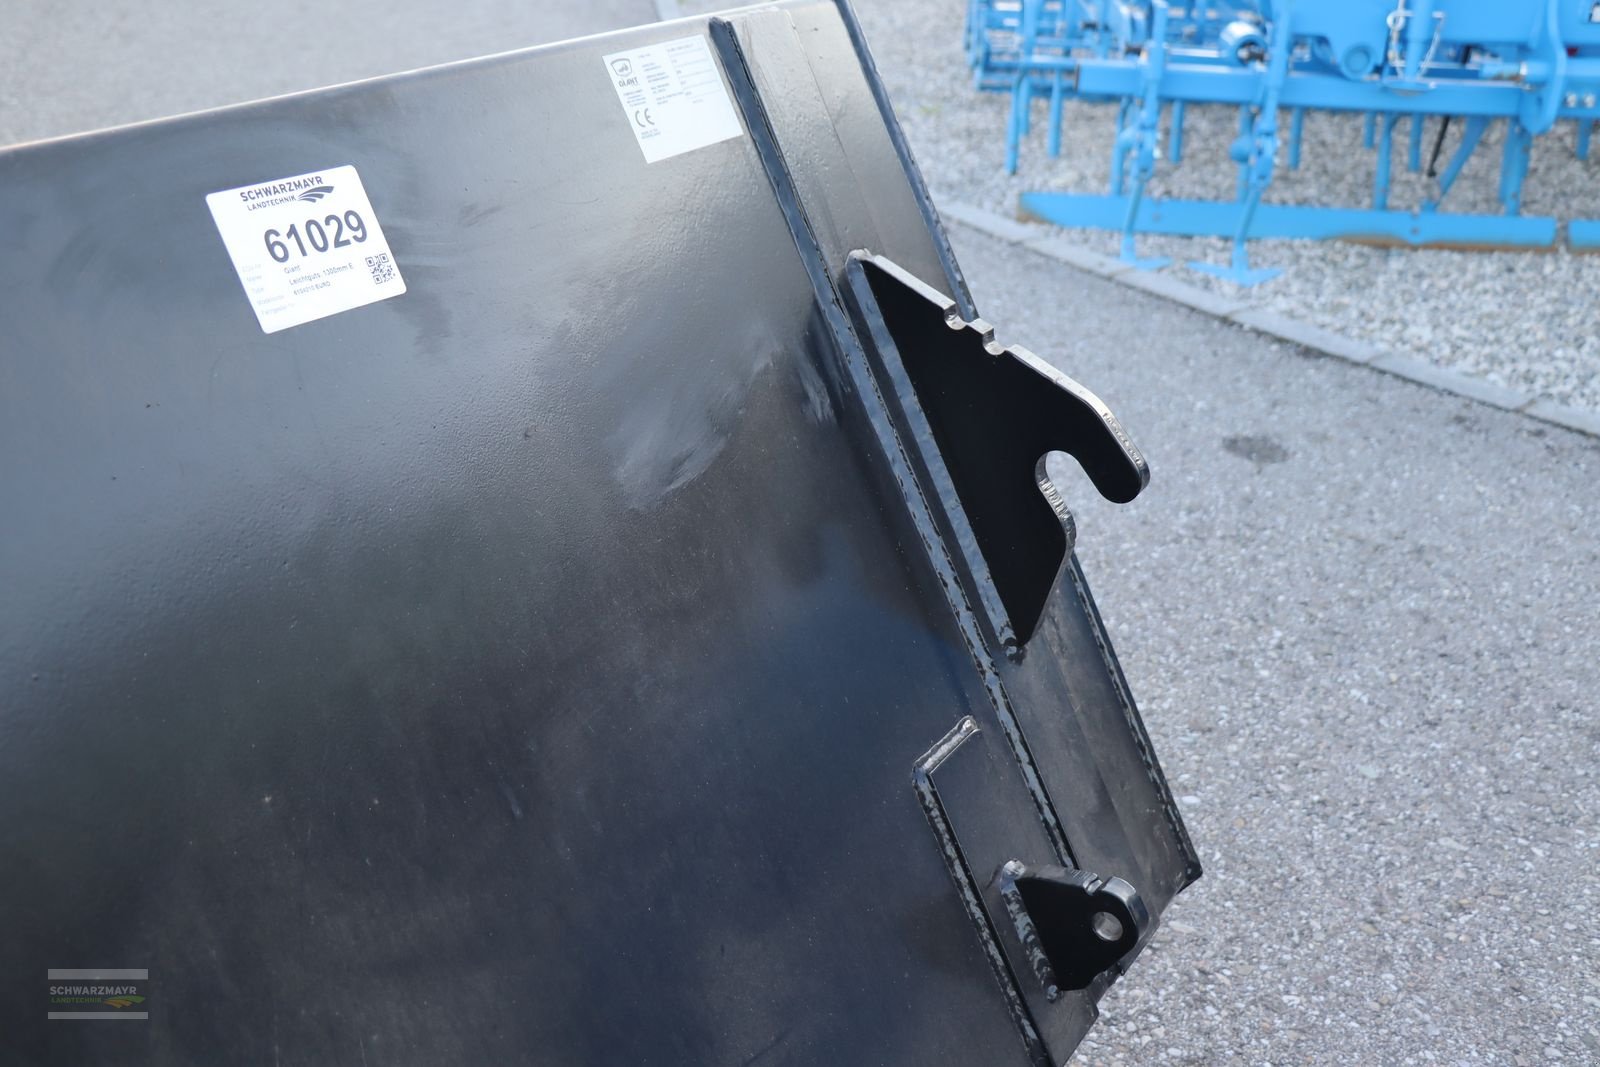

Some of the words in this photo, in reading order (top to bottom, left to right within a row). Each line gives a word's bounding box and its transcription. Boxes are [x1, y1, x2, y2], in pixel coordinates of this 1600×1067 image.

[635, 108, 655, 128] CE
[240, 176, 324, 202] SCHWARZMAYR
[247, 195, 297, 211] LANDTECHNIK
[264, 210, 367, 263] 61029
[284, 265, 301, 274] Giant
